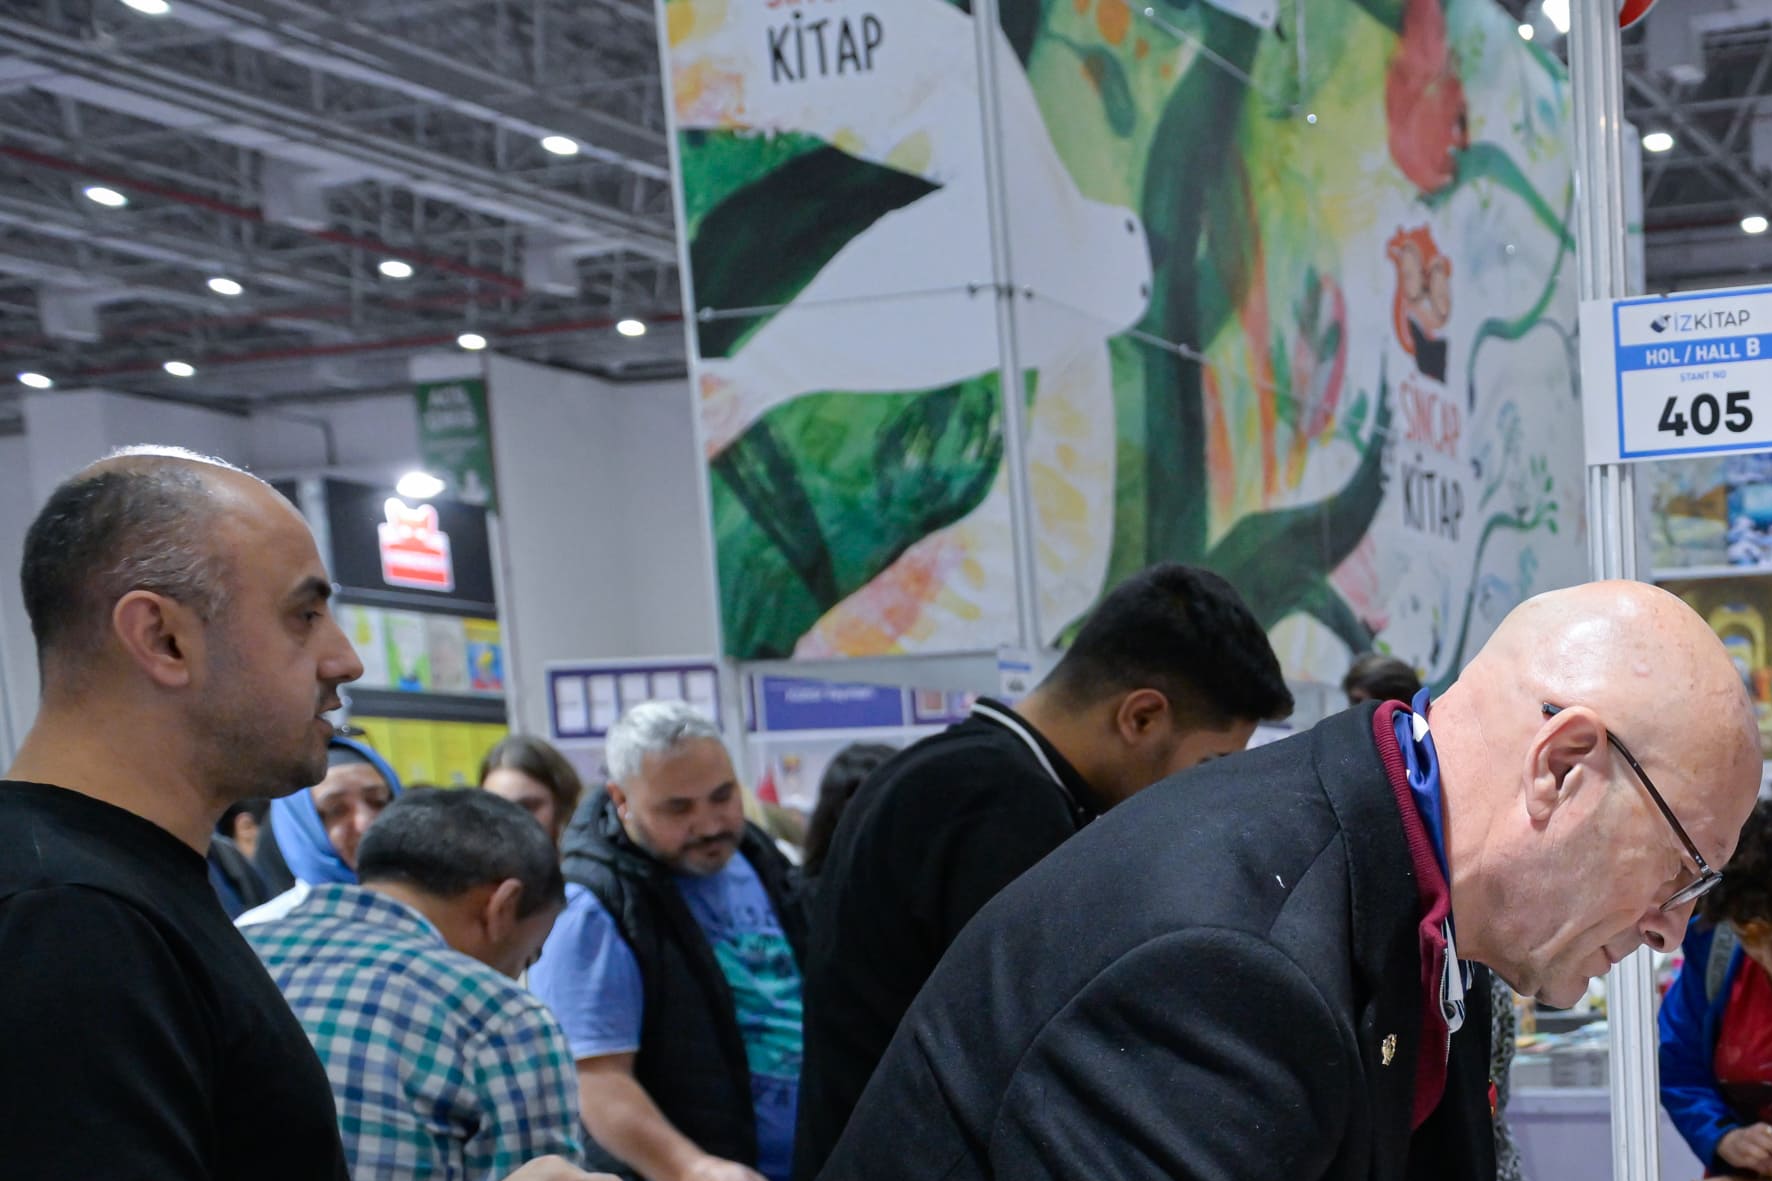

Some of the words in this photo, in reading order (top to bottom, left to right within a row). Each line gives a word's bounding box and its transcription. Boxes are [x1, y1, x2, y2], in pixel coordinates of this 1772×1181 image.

[767, 10, 883, 84] KİTAP
[1674, 309, 1750, 332] İZKİTAP
[1645, 348, 1681, 366] HOL
[1695, 342, 1741, 362] HALL
[1746, 337, 1761, 357] B
[1680, 371, 1710, 382] STANT
[1658, 390, 1753, 436] 405
